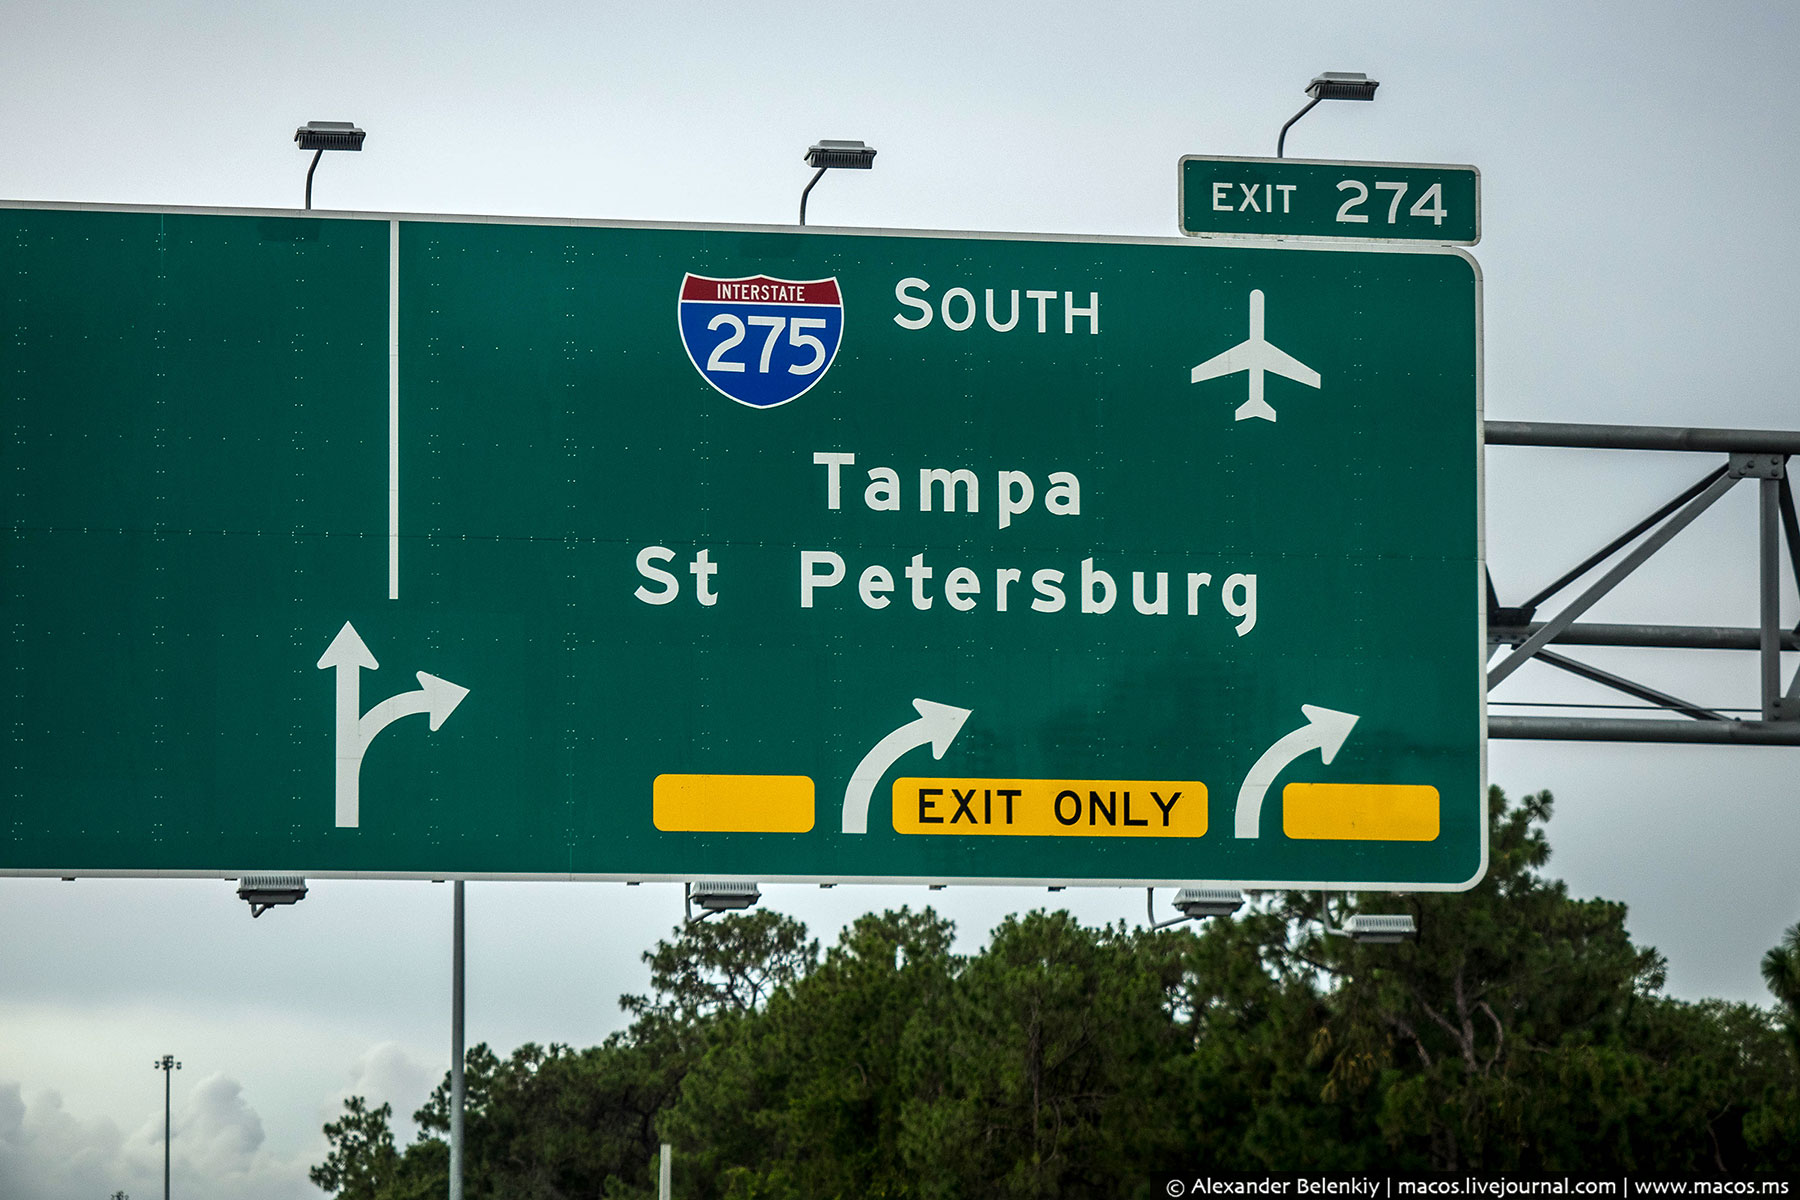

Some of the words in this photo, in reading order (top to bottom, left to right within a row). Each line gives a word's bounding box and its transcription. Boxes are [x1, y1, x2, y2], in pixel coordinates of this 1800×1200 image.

[1212, 182, 1297, 214] EXIT
[1335, 179, 1449, 226] 274
[717, 283, 806, 302] INTERSTATE
[893, 277, 1100, 335] SOUTH
[706, 313, 828, 376] 275
[813, 451, 1082, 530] Tampa
[633, 545, 719, 607] St
[800, 550, 1258, 637] Petersburg
[918, 788, 1022, 825] EXIT
[1053, 789, 1183, 827] ONLY
